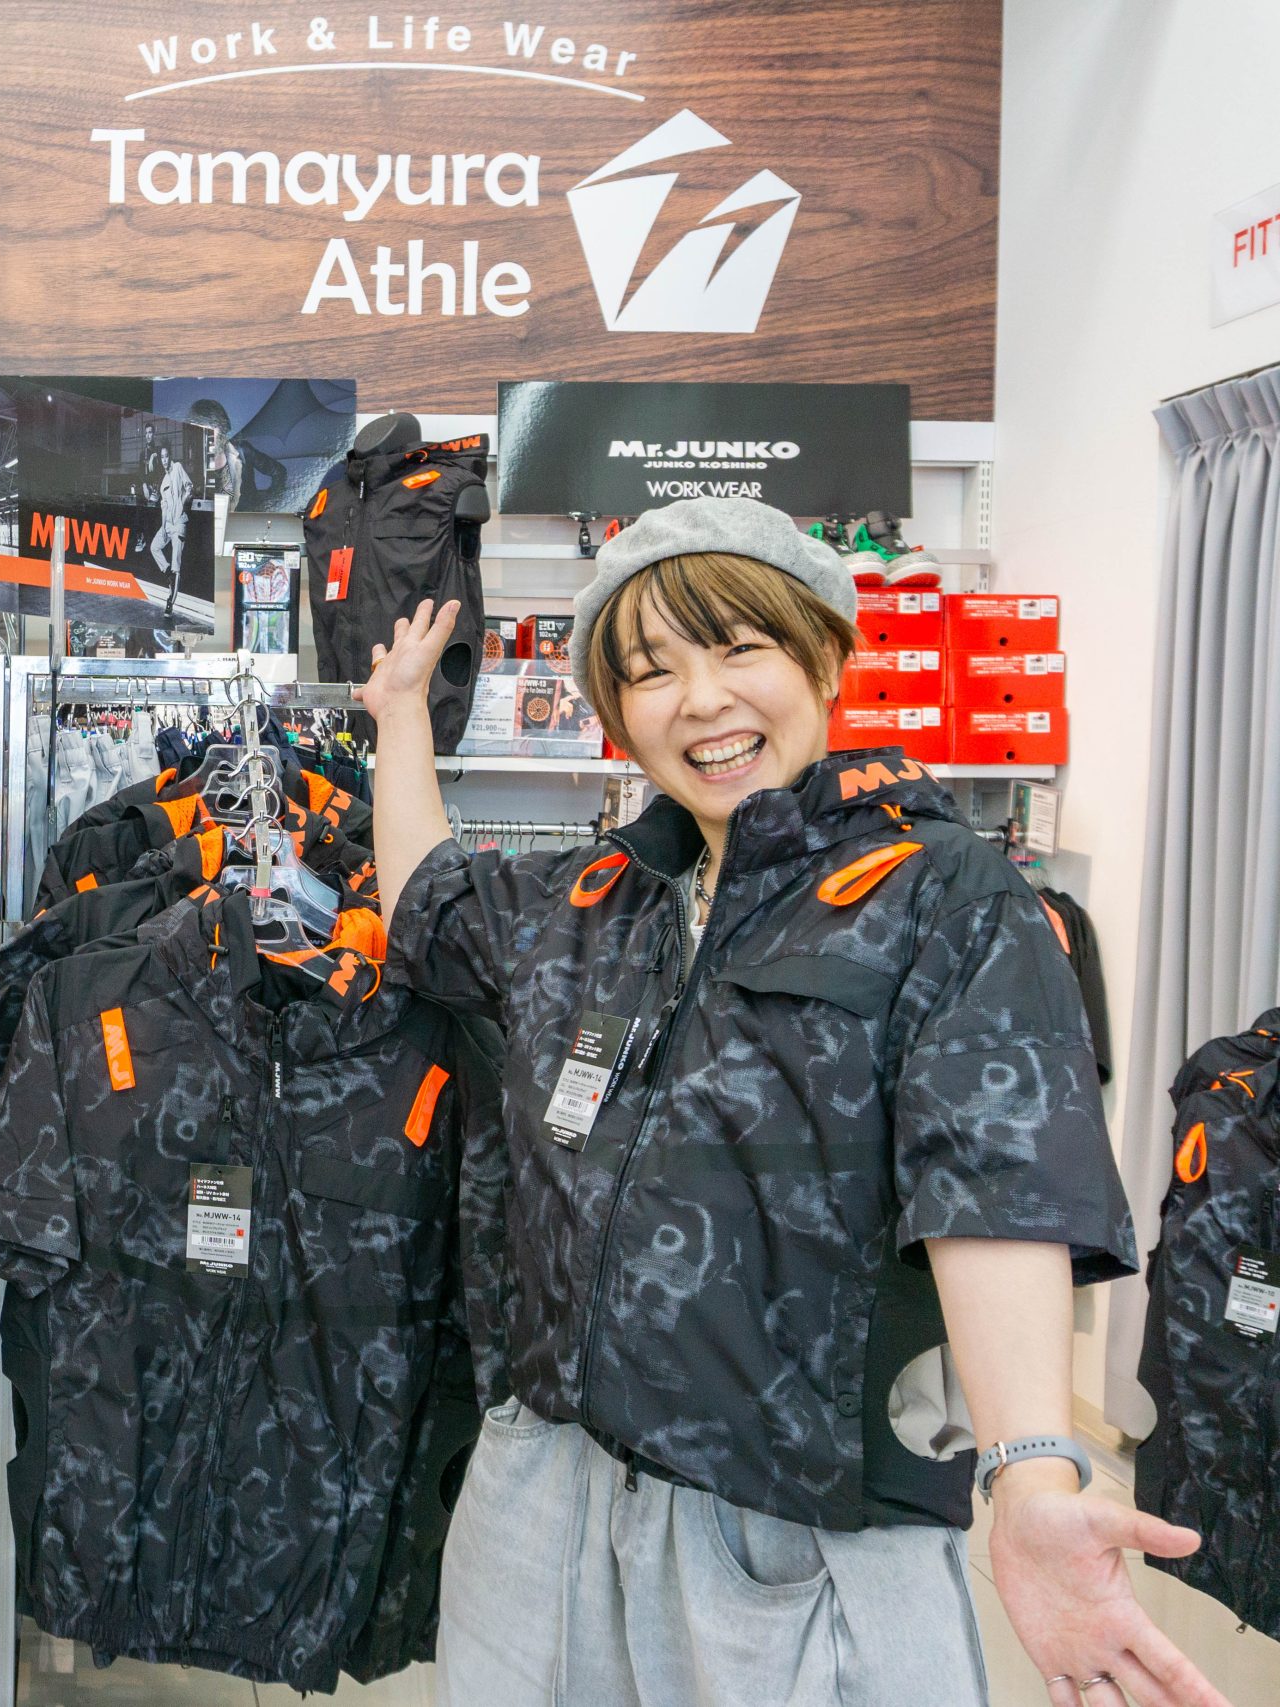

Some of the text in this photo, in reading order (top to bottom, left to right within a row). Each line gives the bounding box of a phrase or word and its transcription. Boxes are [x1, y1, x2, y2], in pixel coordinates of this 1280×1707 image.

[138, 15, 637, 76] Work & Life Wear
[90, 128, 541, 222] Tamayura
[300, 238, 532, 317] Athle
[608, 440, 801, 460] Mr.JUNKO
[643, 460, 768, 470] JUNKO KOSHINO
[646, 480, 763, 499] WORK WEAR
[203, 1211, 241, 1222] MJWW-14
